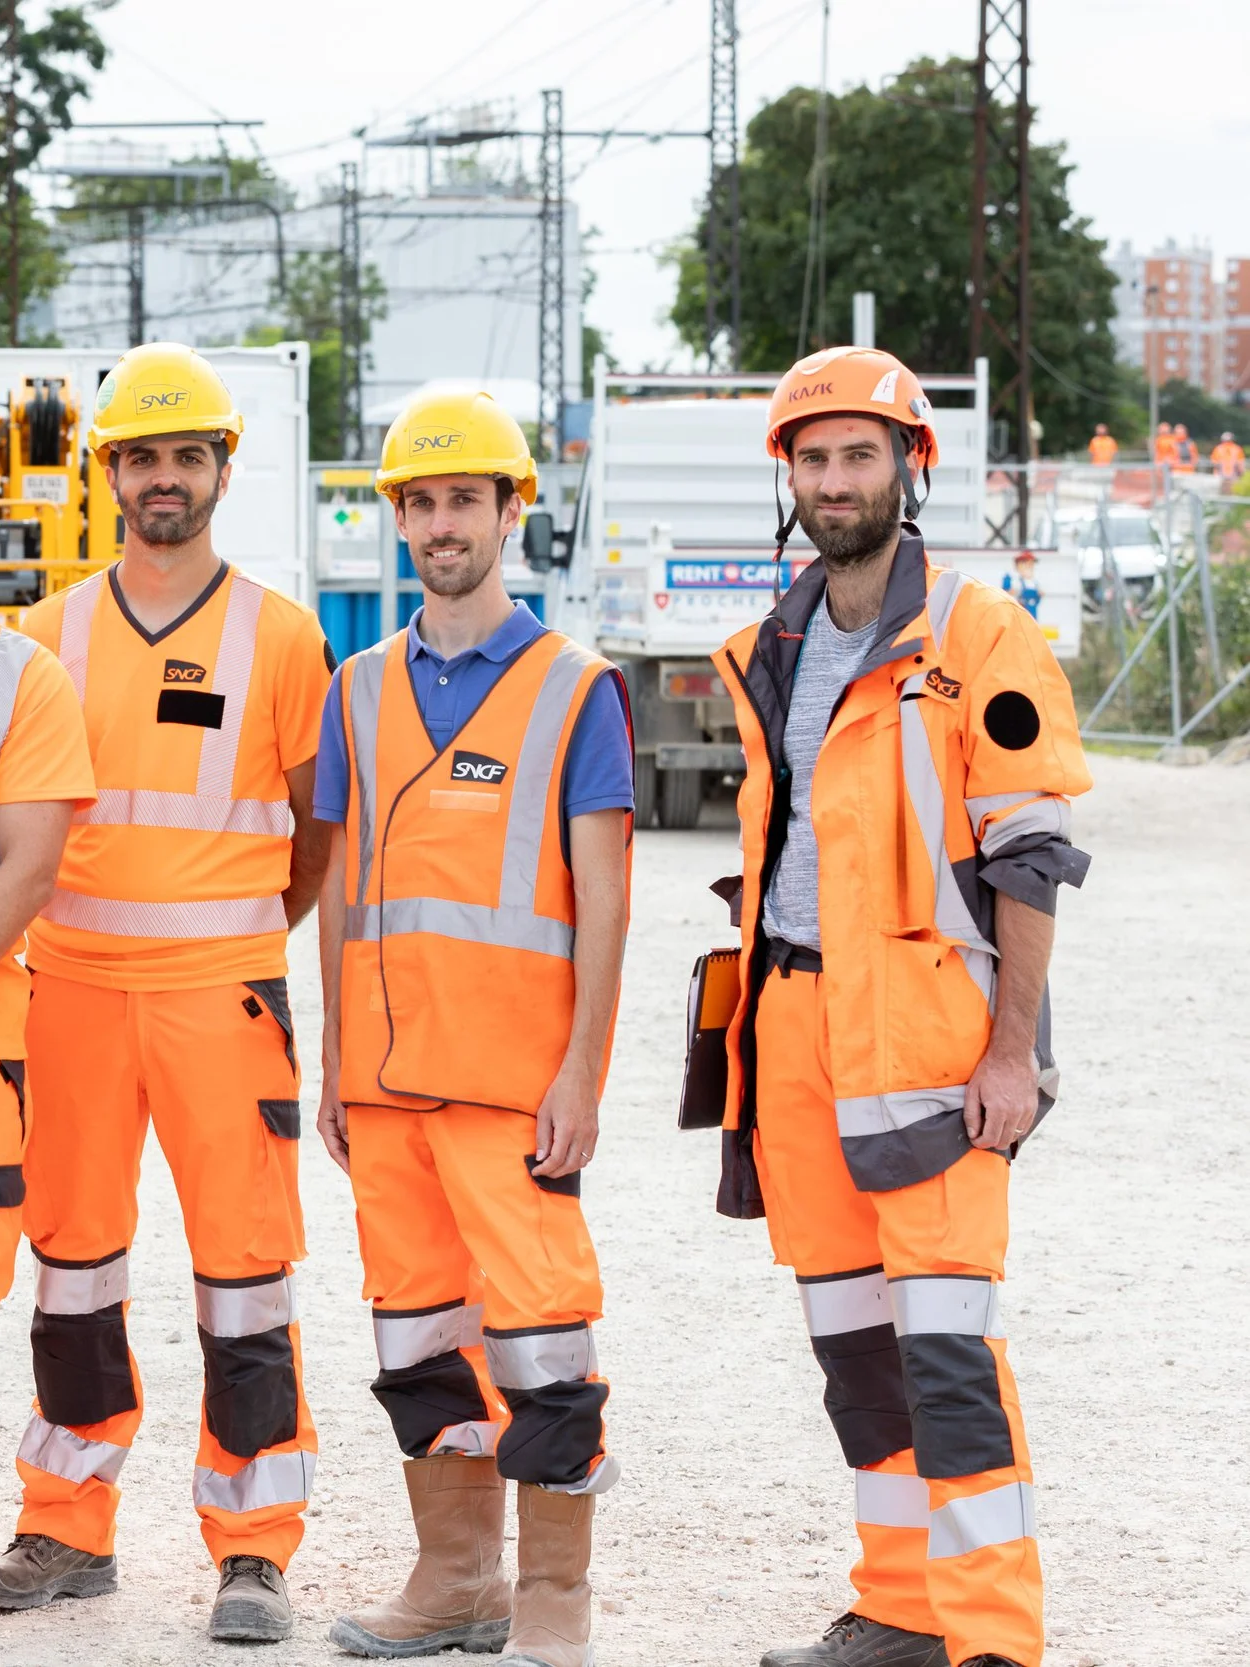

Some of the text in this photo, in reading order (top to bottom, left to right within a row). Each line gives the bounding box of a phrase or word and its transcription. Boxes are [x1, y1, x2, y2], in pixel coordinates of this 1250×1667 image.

[139, 391, 186, 410] SNCF
[788, 382, 833, 403] KASK
[412, 434, 462, 452] SNCF
[671, 564, 721, 583] RENT
[165, 667, 203, 682] SNCF
[926, 673, 963, 696] SNCF
[452, 762, 506, 780] SNCF
